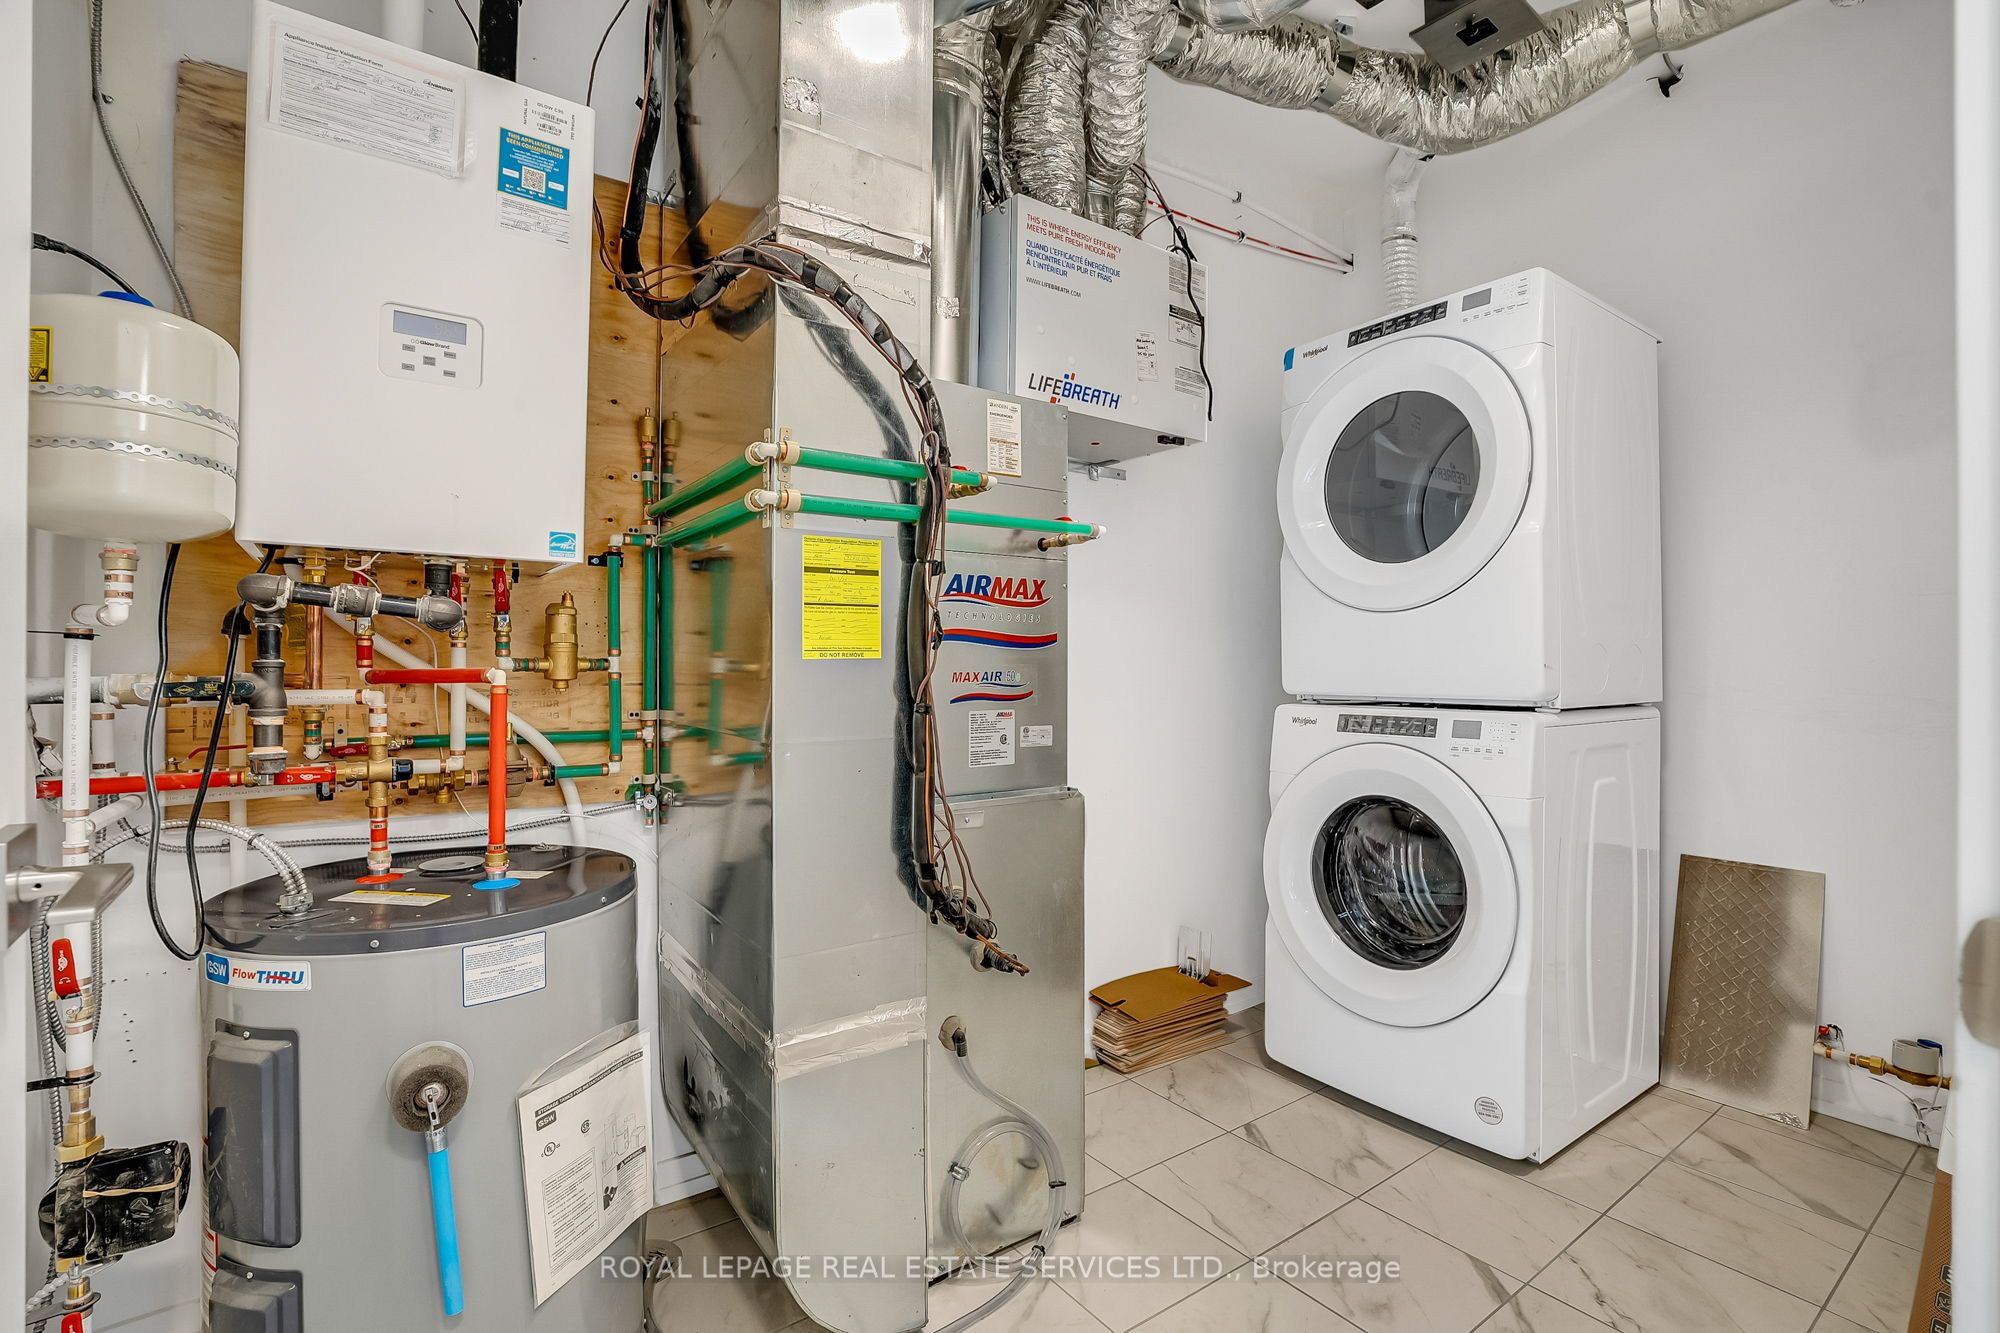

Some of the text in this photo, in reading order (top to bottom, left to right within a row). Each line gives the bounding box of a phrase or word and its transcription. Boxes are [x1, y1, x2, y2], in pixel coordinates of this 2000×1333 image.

[284, 32, 384, 68] Appliance Installer Validation Form
[506, 137, 564, 159] BEEN COMMISSIONED
[507, 131, 563, 154] THIS APPLIANCE HAS
[1026, 223, 1116, 260] MEETS PURE FRESH INDOOR AIR
[1027, 213, 1122, 254] THIS IS WHERE ENERGY EFFICIENCY
[1026, 239, 1121, 278] QUAND L'EFFICACITÉ ÉNERGÉTIQUE
[1026, 248, 1113, 283] RENCONTRE L'AIR PUR ET FRAIS
[1026, 256, 1068, 278] À L'INTÉRIEUR
[1026, 276, 1082, 298] WWW.LIFEBREATH.COM
[1302, 345, 1329, 359] Whirlpool
[1028, 373, 1121, 410] LIFEBREATH
[944, 573, 1047, 601] AIRMAX
[947, 611, 1041, 623] TECHNOLOGIES
[951, 671, 1002, 683] MAXAIR
[1291, 716, 1318, 727] Whirlpool
[207, 960, 227, 976] GSW
[537, 1100, 559, 1114] STORAGE
[560, 1092, 573, 1103] TANKS
[573, 1087, 583, 1096] FOR
[537, 1112, 556, 1127] GSW
